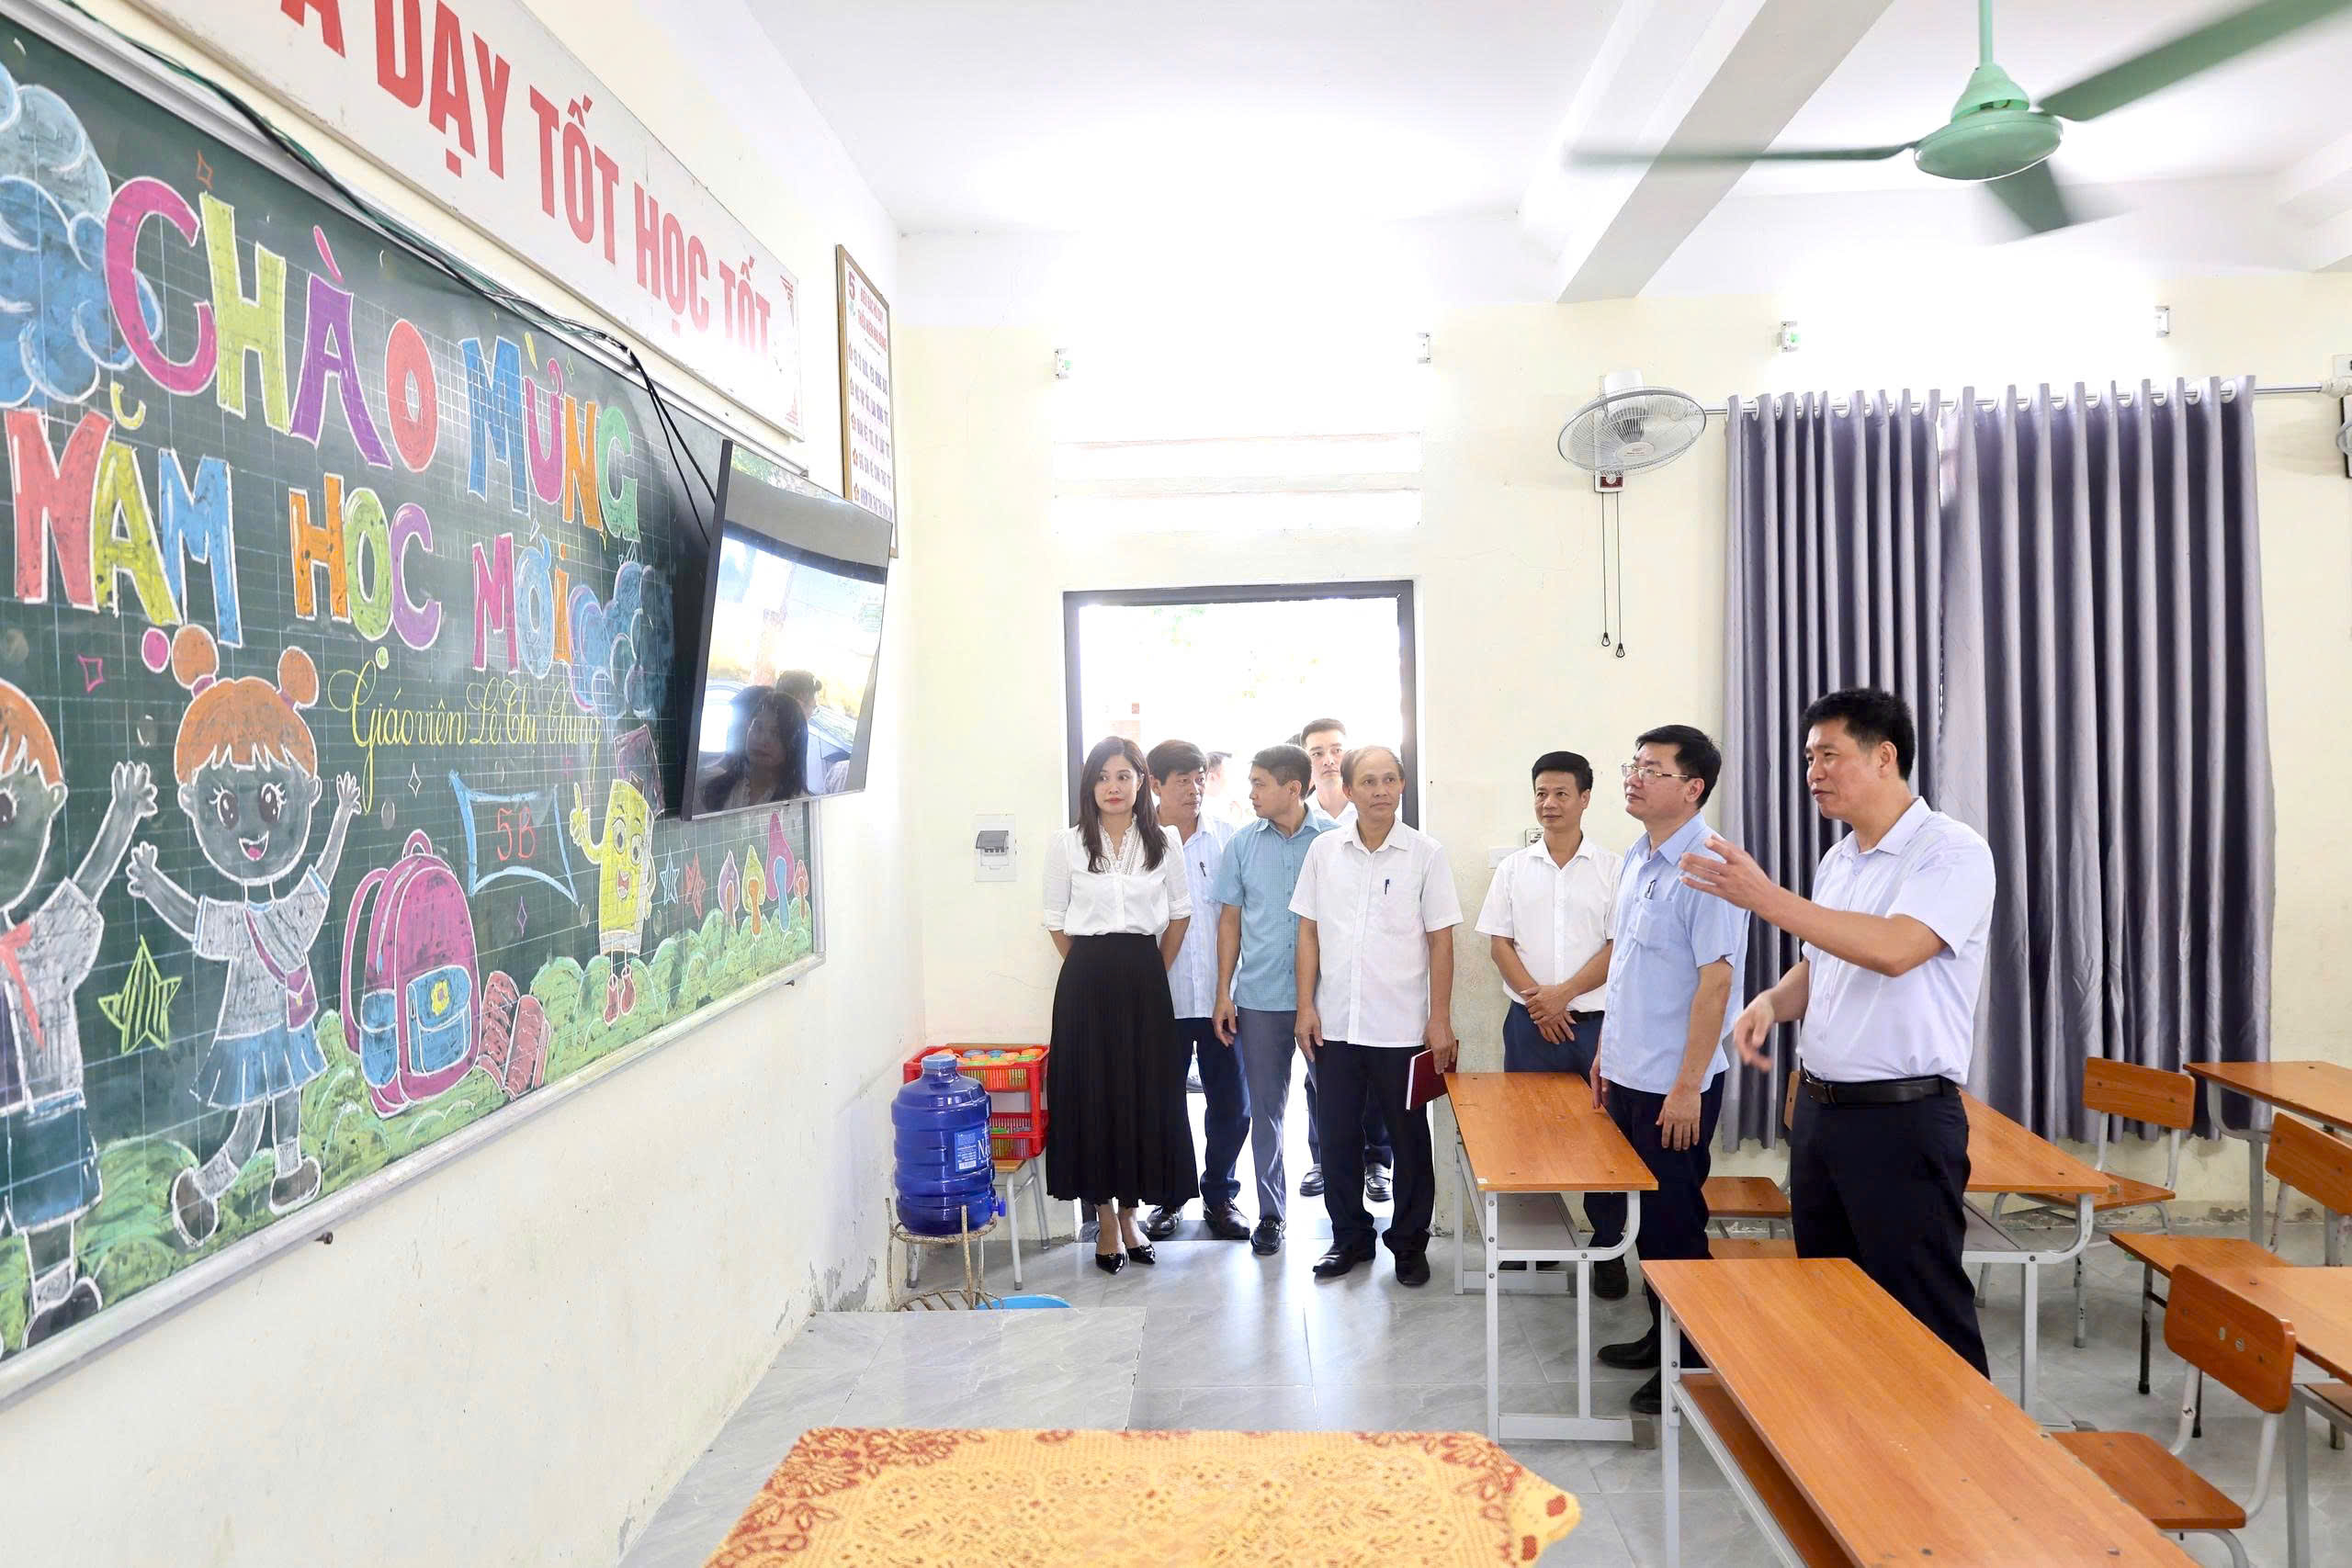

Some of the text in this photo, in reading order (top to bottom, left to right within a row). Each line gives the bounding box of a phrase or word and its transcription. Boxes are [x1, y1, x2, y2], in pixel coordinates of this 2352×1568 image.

[104, 176, 639, 544] CHÀO MỪNG
[529, 84, 619, 265] TỐT
[634, 181, 709, 338] HỌC
[718, 254, 771, 361] TỐT
[4, 381, 243, 649] NĂM
[288, 473, 442, 670] HỌC
[328, 660, 413, 816] Giáo
[466, 676, 503, 746] Lê
[496, 807, 537, 862] 5B
